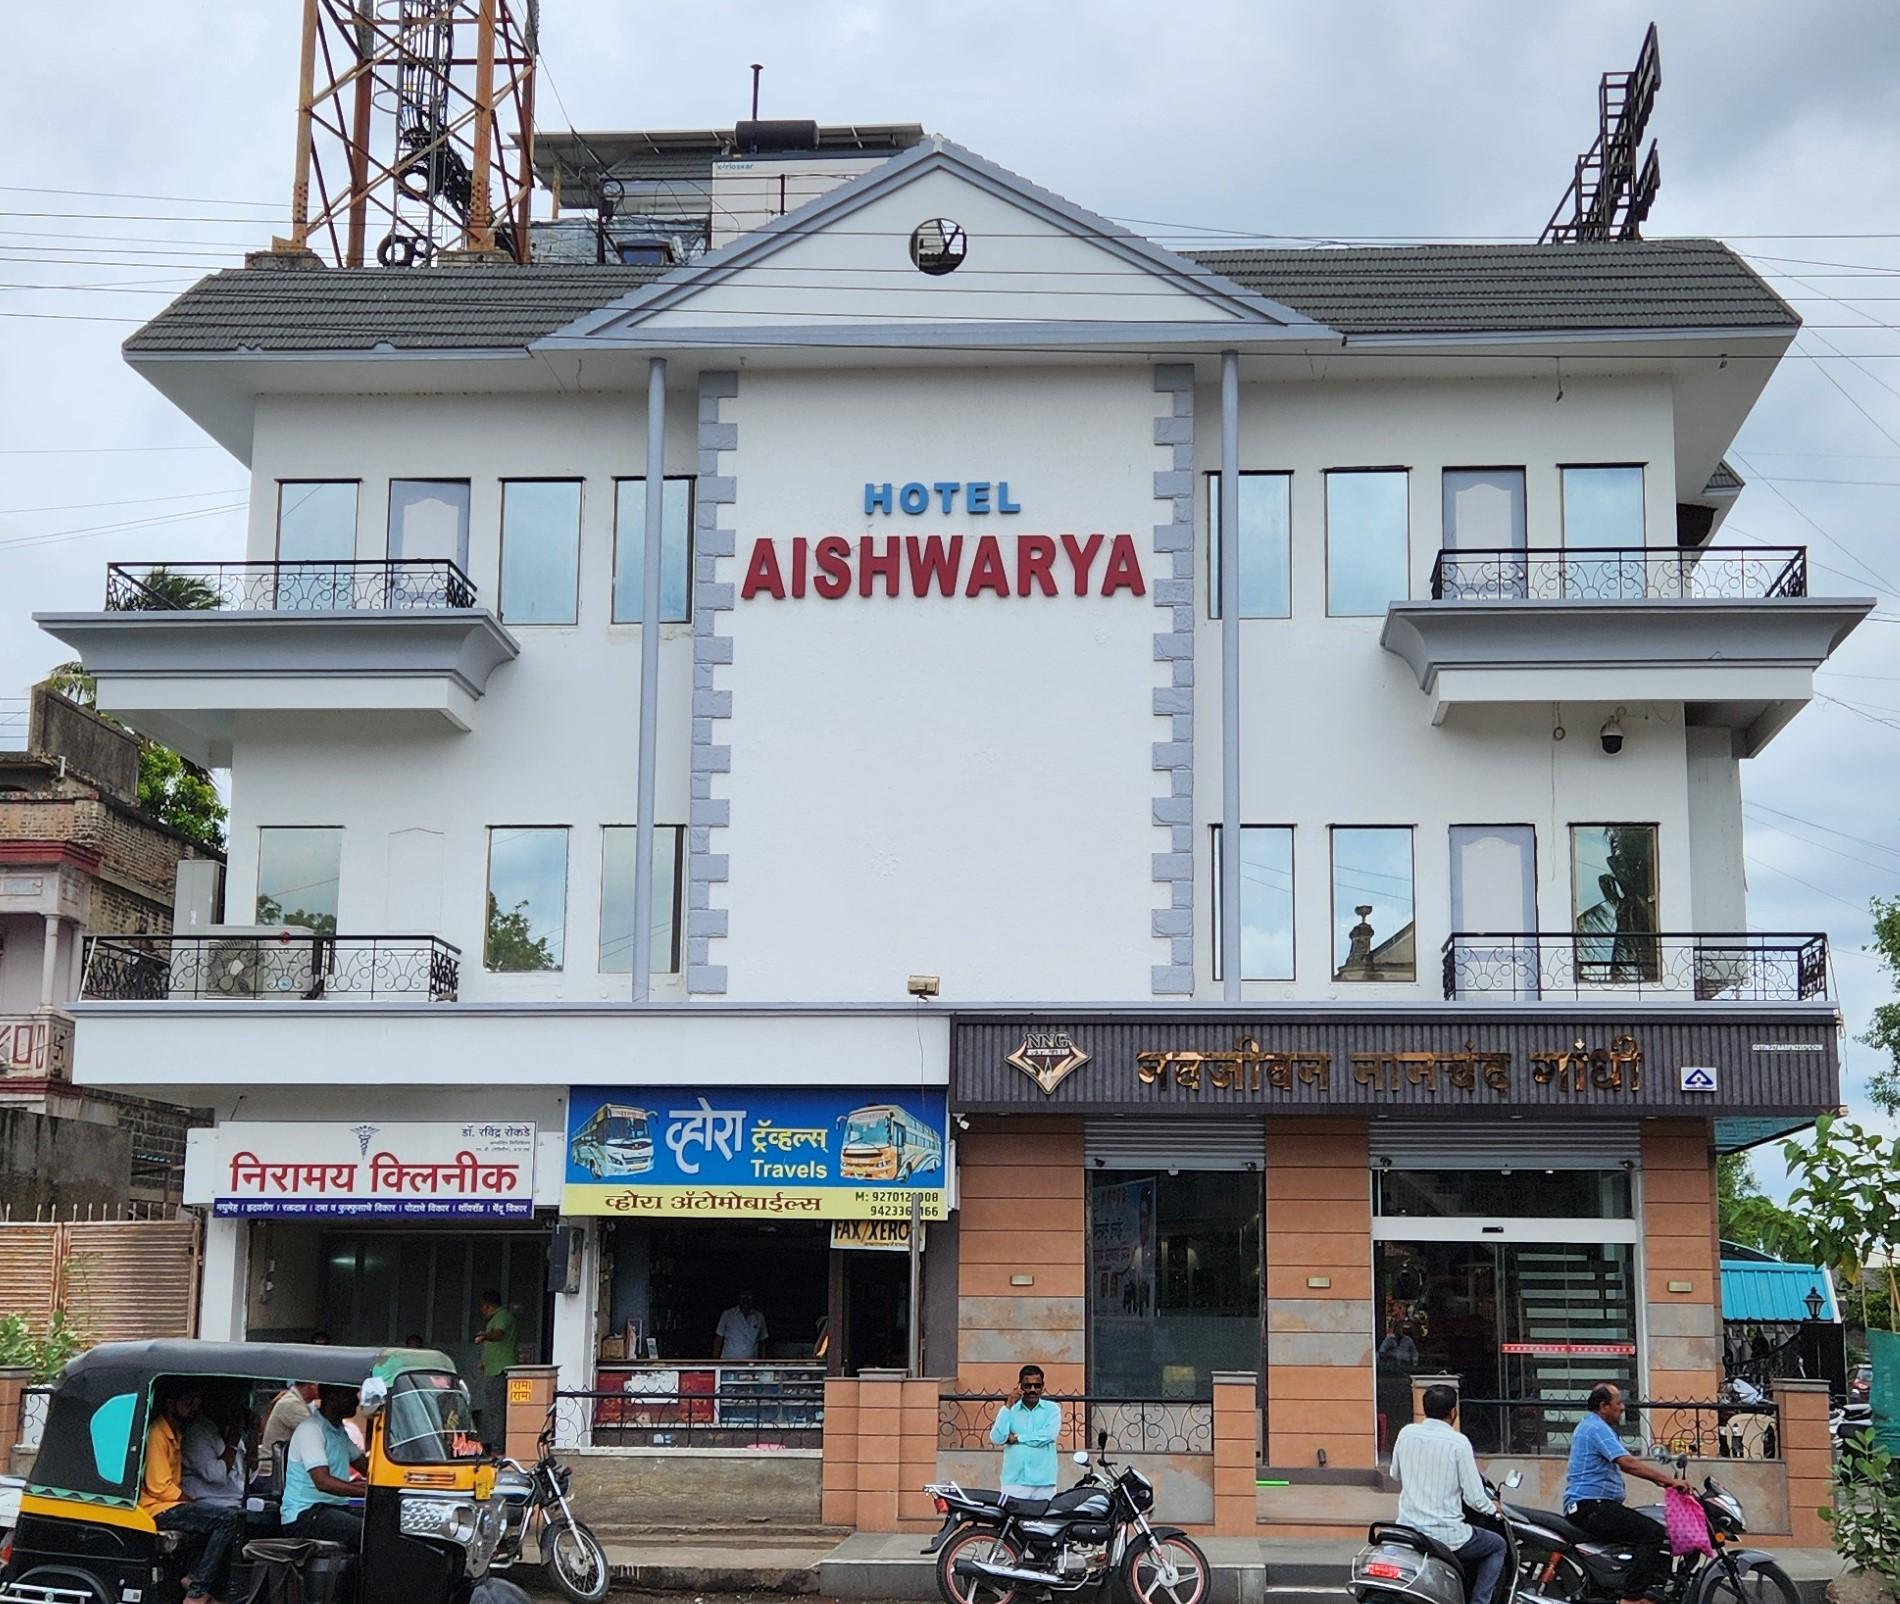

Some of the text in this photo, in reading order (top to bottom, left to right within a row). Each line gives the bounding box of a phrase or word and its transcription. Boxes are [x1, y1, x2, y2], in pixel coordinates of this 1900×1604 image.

[864, 482, 1020, 515] HOTEL
[741, 534, 1146, 599] AISHWARYA
[1026, 1033, 1069, 1048] NNG
[1136, 1034, 1331, 1091] नवजीवन
[665, 1097, 747, 1174] व्होरा
[229, 1150, 519, 1193] निरामय क्लिनीक
[751, 1159, 828, 1179] Travels
[605, 1190, 663, 1211] व्होरा
[856, 1192, 939, 1202] M: 927012008
[871, 1206, 939, 1216] 942336166
[834, 1220, 923, 1243] FAX/XERO
